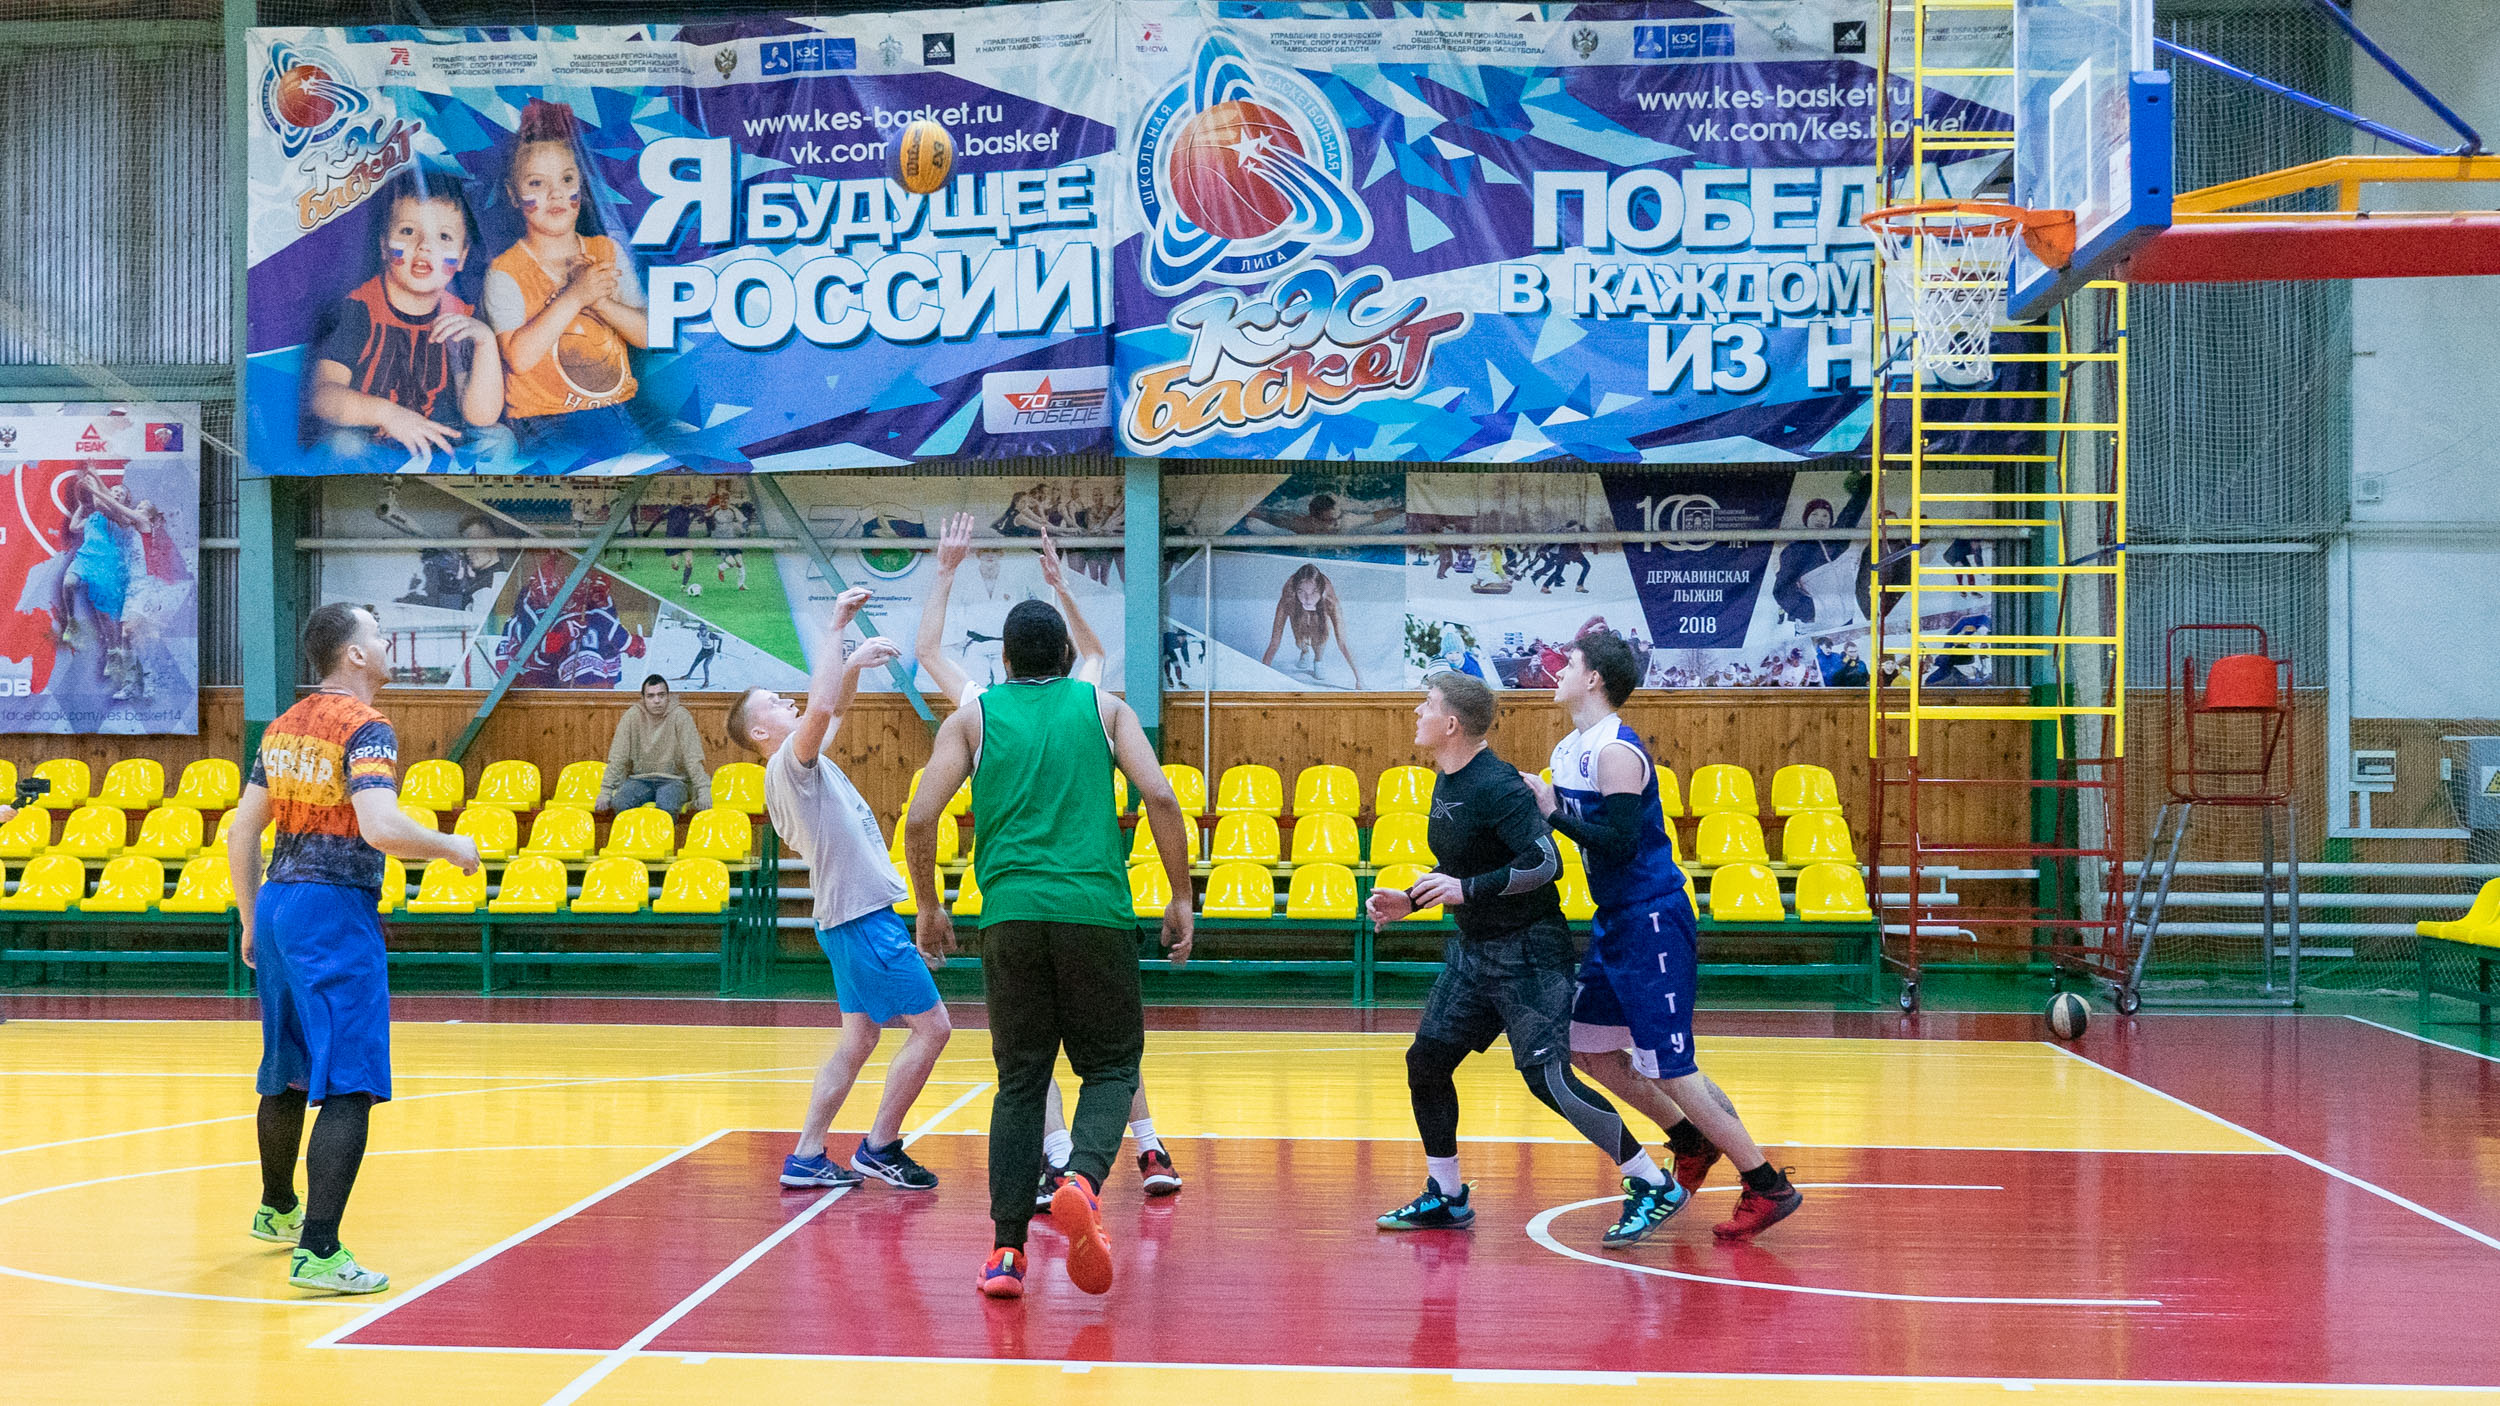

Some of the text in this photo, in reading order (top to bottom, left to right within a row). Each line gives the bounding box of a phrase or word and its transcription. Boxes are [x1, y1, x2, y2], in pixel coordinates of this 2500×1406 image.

[1671, 33, 1697, 44] КЭС
[743, 102, 1004, 137] www.kes-basket.ru
[1138, 104, 1173, 206] ШКОЛЬНАЯ
[632, 137, 1095, 250] Я БУДУЩЕЕ
[1240, 251, 1288, 272] ЛИГА
[648, 242, 1102, 351] РОССИИ
[1575, 261, 1874, 321] КАЖДОМ
[1648, 321, 1769, 393] ИЗ
[1018, 394, 1049, 409] 70
[1014, 407, 1102, 426] ПОБЕДЕ
[75, 441, 107, 453] PEAK
[1646, 570, 1750, 585] ДЕРЖАВИНСКАЯ
[1672, 589, 1724, 603] ЛЫЖНЯ
[1679, 616, 1717, 634] 2018
